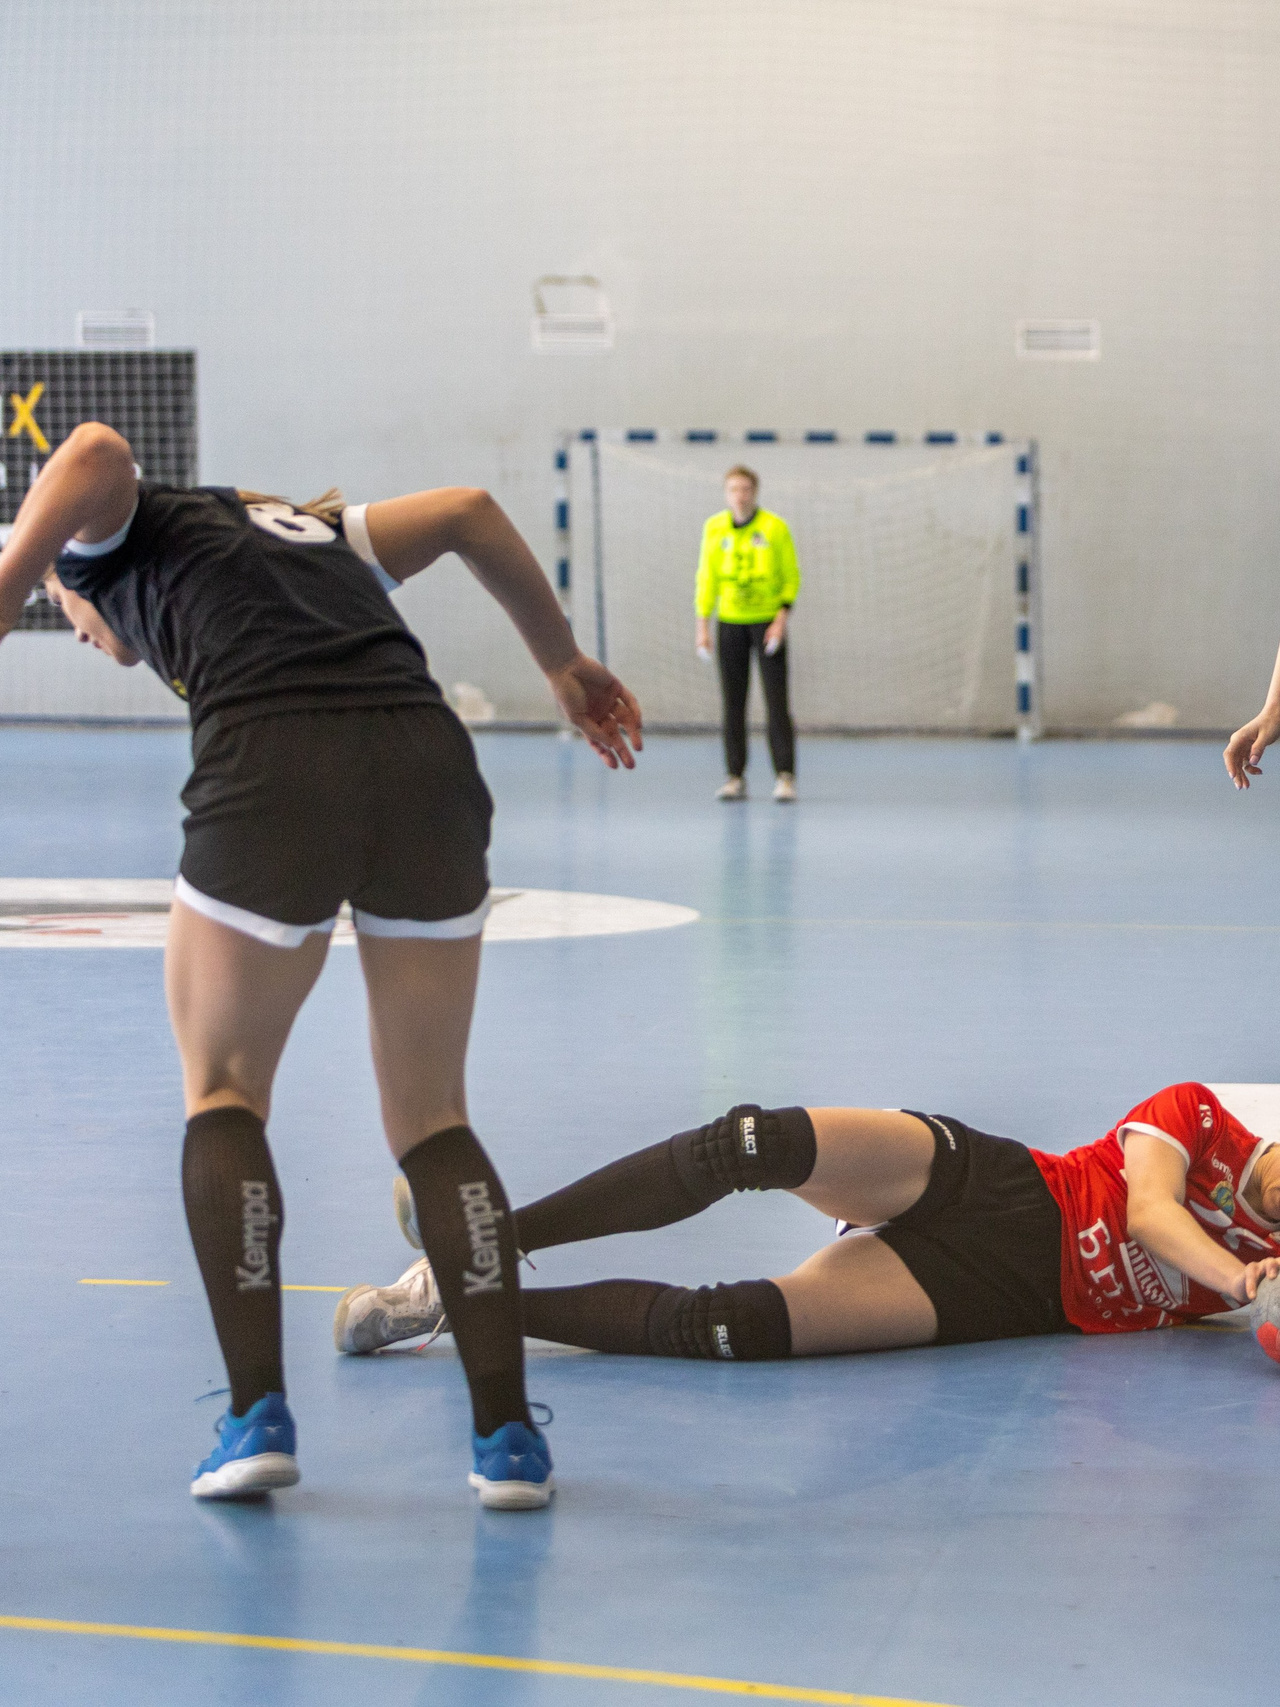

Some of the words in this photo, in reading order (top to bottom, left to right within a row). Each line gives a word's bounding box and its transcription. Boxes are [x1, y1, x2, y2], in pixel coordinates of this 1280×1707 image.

[743, 1116, 757, 1155] SELECT
[235, 1180, 278, 1292] Kempa
[459, 1181, 503, 1296] Kempa
